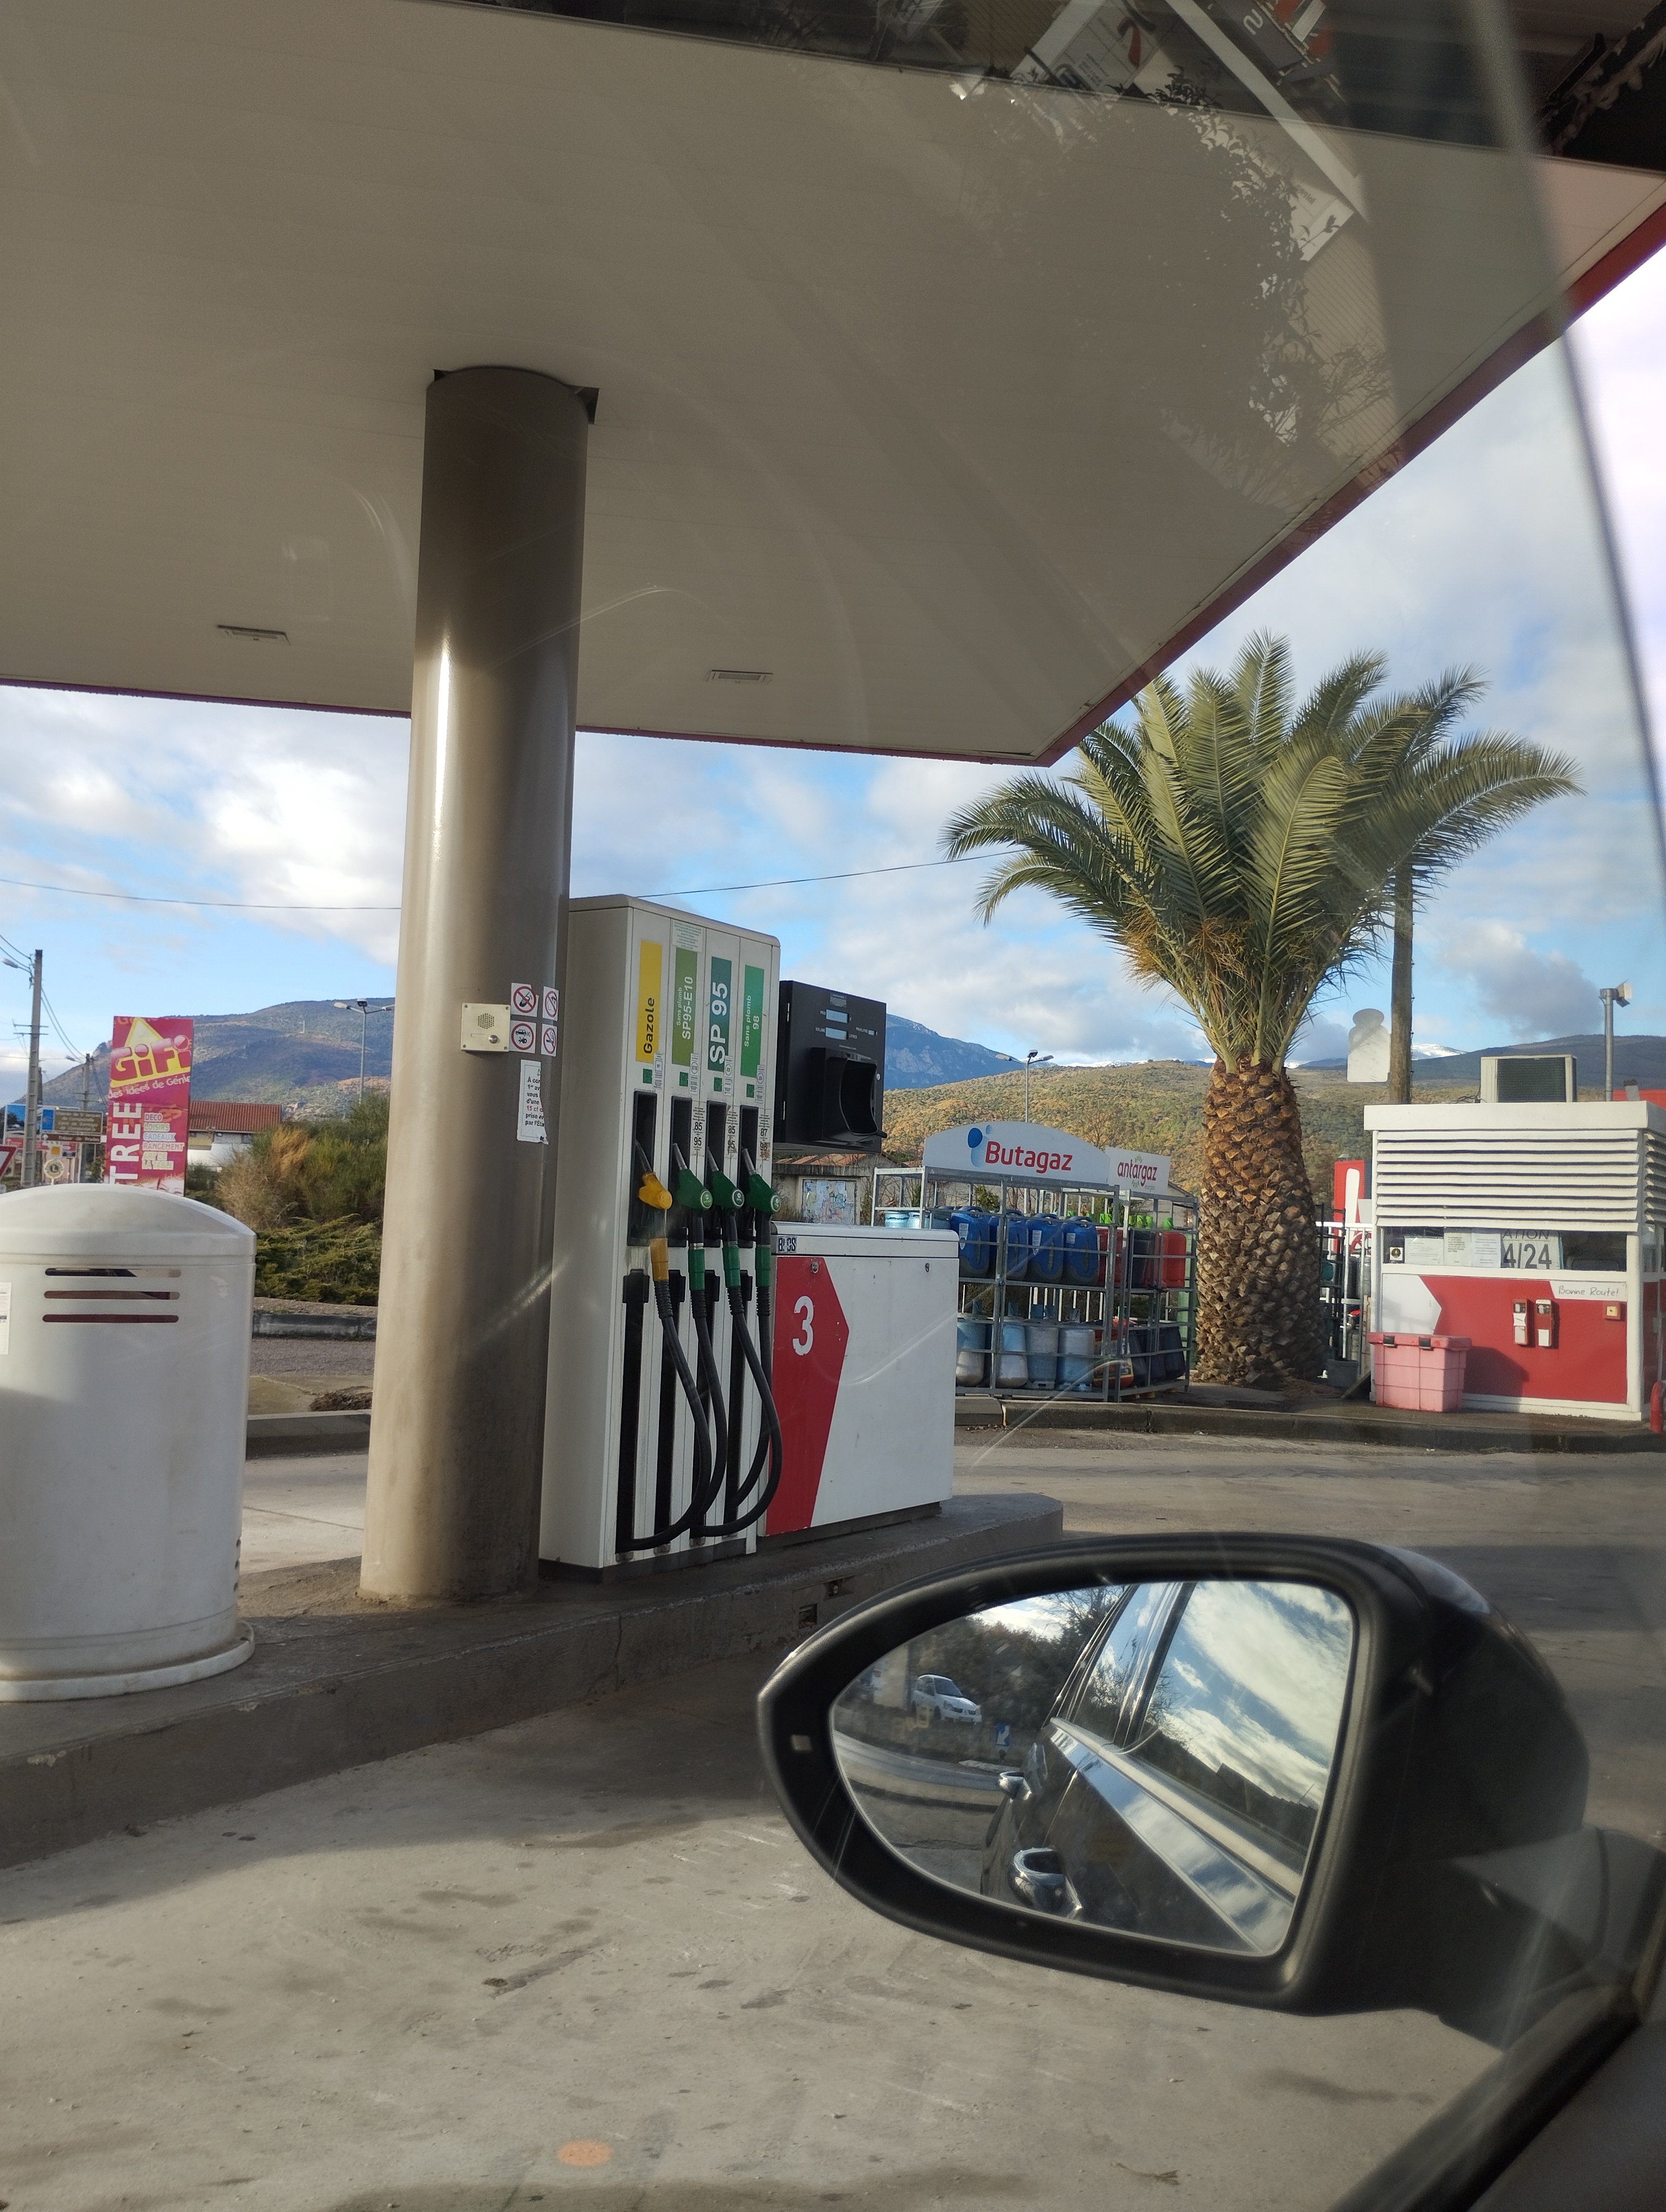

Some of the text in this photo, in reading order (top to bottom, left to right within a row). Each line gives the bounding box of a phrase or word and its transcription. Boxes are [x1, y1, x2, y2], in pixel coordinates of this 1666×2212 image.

[682, 976, 693, 1040] SP95-E10
[643, 997, 655, 1054] Gazole
[709, 982, 728, 1064] SP 95
[753, 1015, 759, 1030] 98
[152, 1080, 165, 1089] de
[144, 1123, 169, 1131] LOISIRS
[695, 1121, 703, 1131] 85
[760, 1128, 768, 1137] 87
[144, 1133, 175, 1141] CADEAUX
[694, 1136, 702, 1146] 95
[985, 1141, 1073, 1174] Butagaz
[1117, 1159, 1158, 1187] antargaz
[1558, 1285, 1619, 1297] Bonne Route!
[792, 1295, 814, 1356] 3
